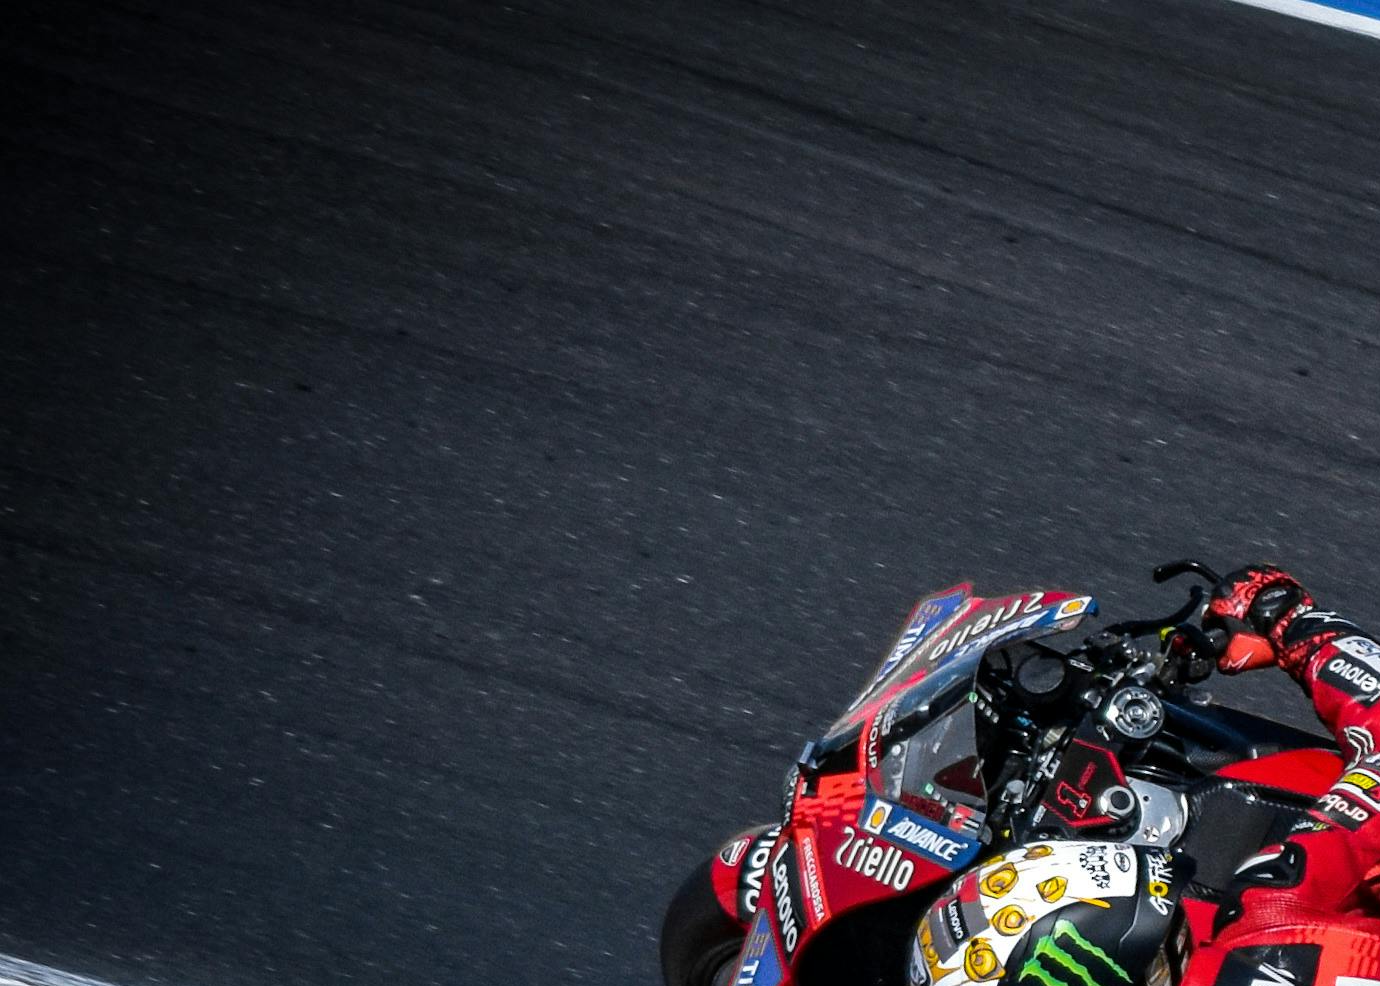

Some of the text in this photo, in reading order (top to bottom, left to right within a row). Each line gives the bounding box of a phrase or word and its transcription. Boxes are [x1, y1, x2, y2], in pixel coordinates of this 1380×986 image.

[846, 837, 914, 891] riello
[888, 818, 962, 861] ADVANCE
[773, 843, 798, 952] Lenovo
[803, 837, 825, 921] FRECCIAROSSA
[948, 900, 964, 940] Lenovo
